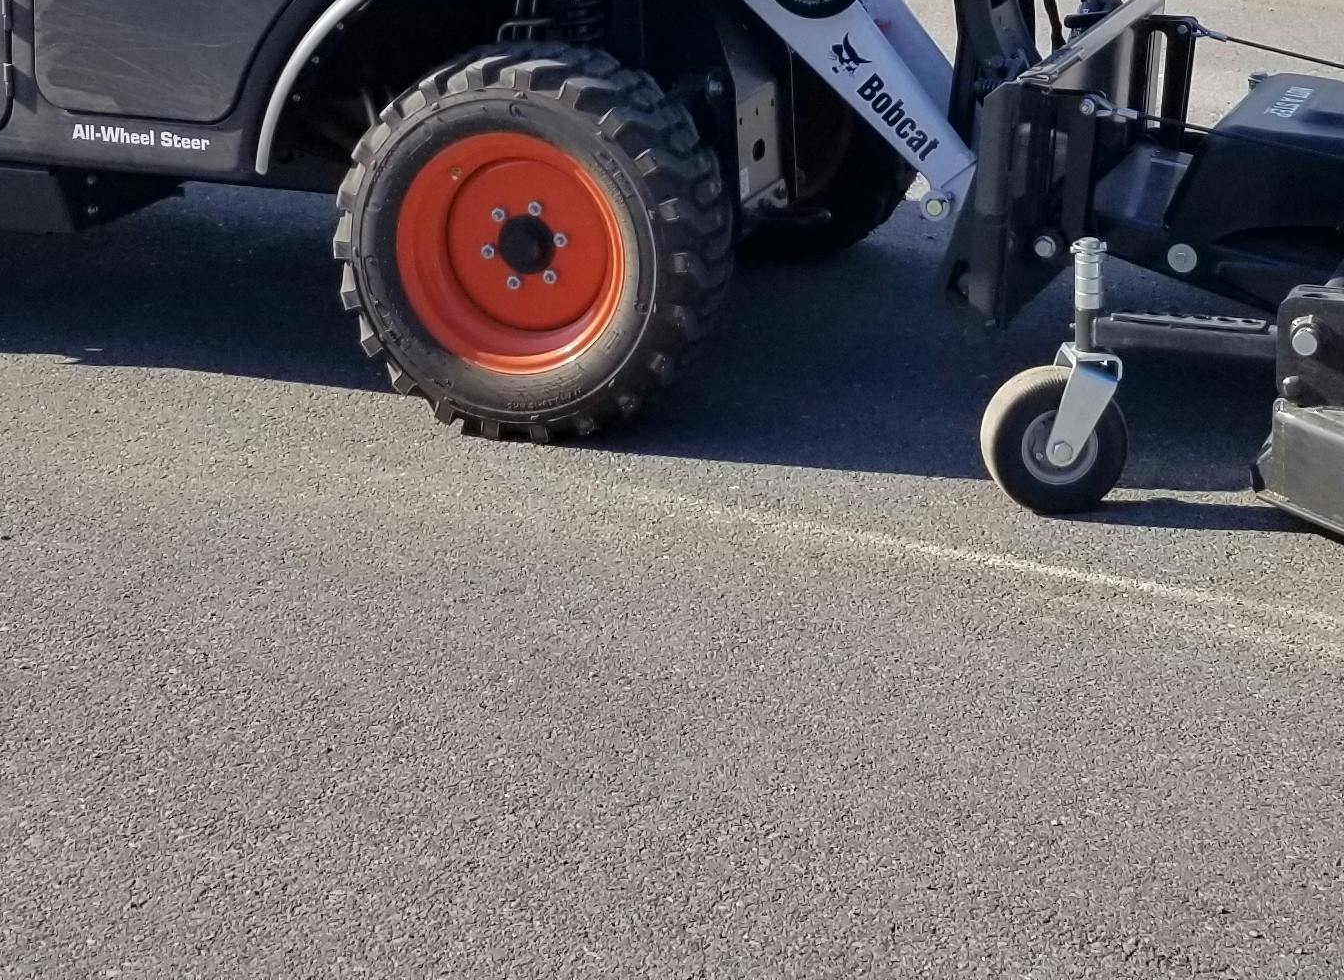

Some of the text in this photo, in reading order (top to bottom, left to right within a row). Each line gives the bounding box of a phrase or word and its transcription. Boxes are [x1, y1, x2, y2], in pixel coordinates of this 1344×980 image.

[72, 123, 210, 151] All-Wheel Steer
[857, 72, 940, 162] Bobcat
